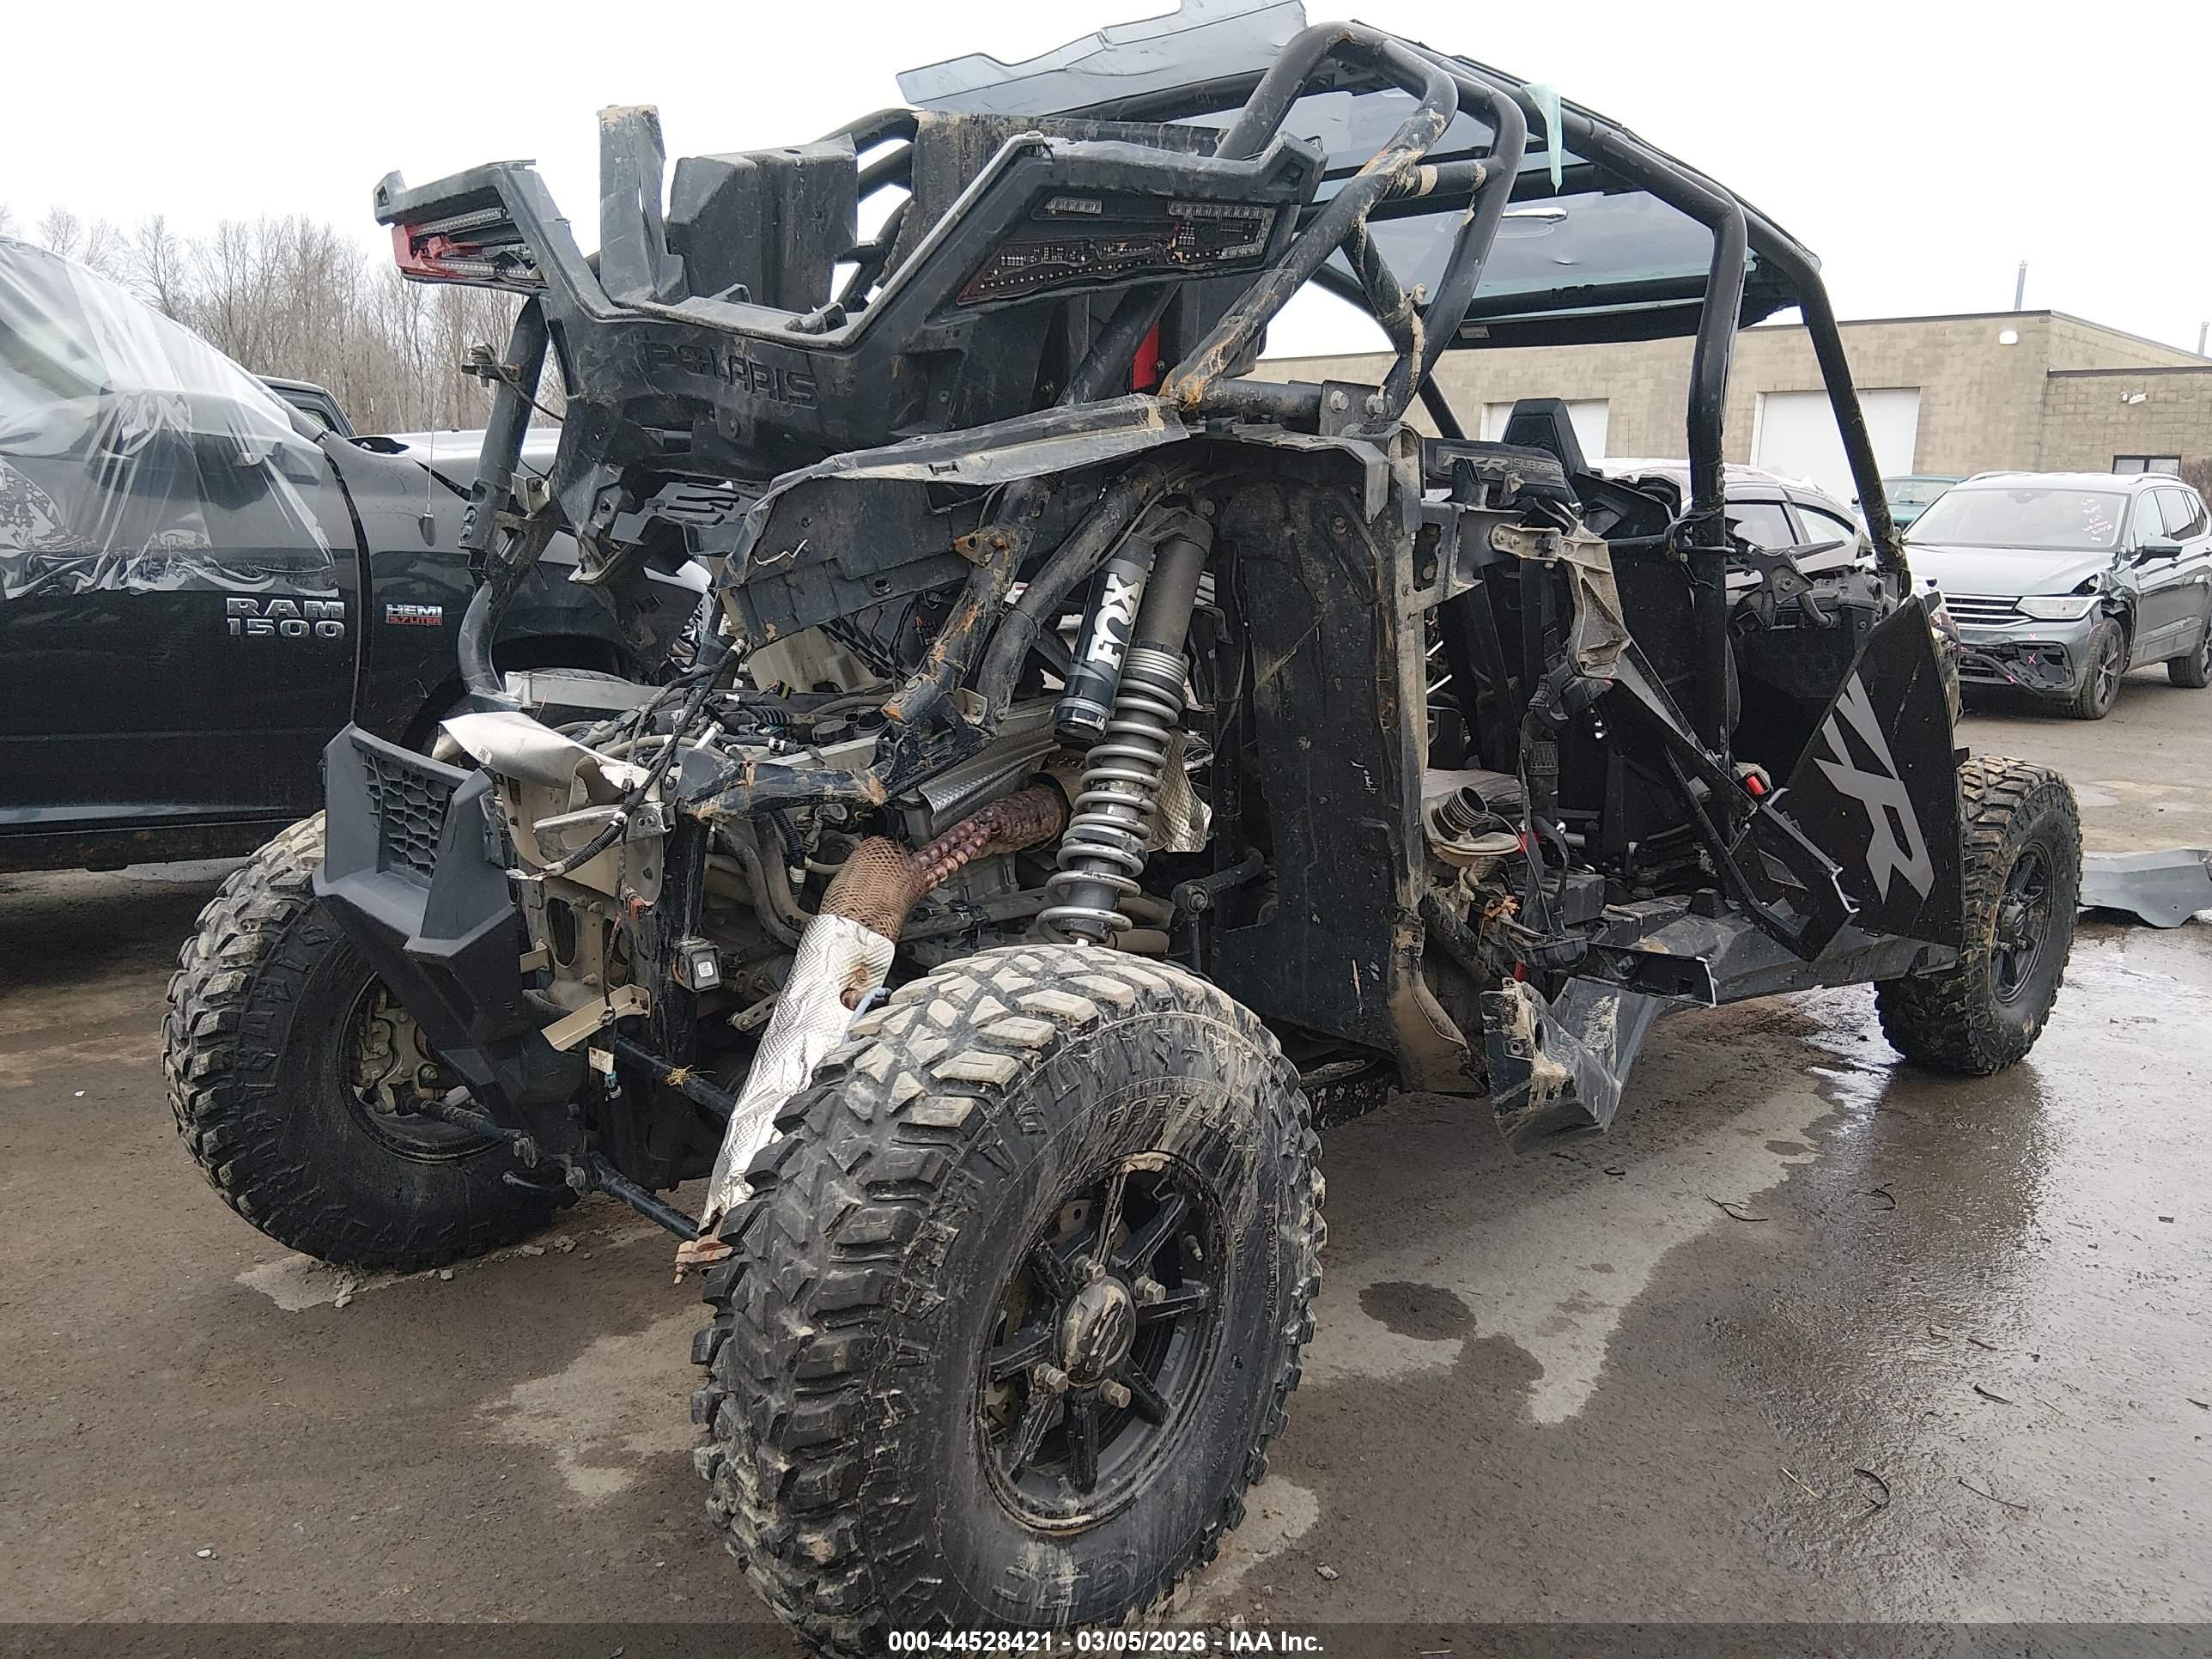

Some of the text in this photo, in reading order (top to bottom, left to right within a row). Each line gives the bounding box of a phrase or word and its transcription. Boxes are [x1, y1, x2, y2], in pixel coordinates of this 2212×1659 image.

[645, 343, 819, 410] POLARIS
[1514, 459, 1535, 470] SUB
[227, 598, 344, 618] RAM
[386, 604, 442, 616] HEMI
[227, 618, 345, 638] 1500
[1086, 573, 1140, 672] FOX
